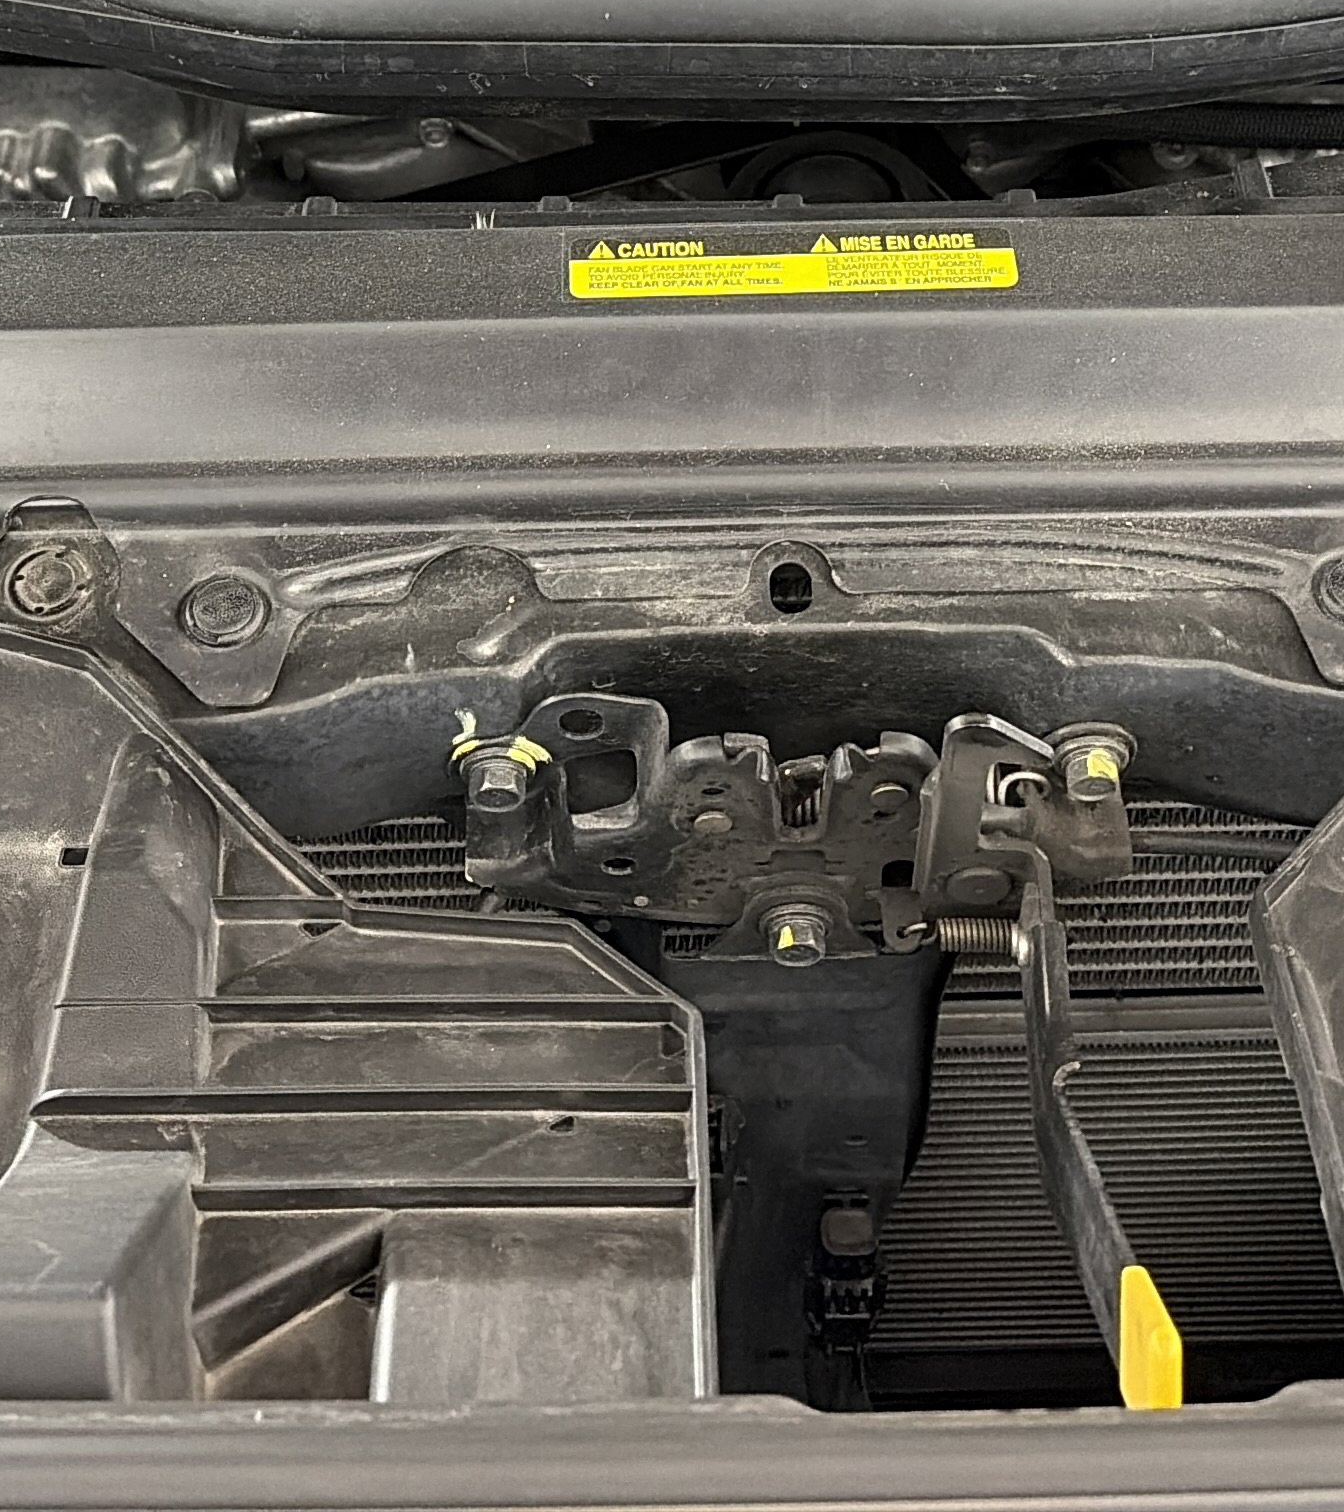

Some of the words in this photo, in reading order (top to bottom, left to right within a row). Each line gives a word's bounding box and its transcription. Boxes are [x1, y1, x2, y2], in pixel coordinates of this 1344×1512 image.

[839, 235, 883, 252] MISE
[885, 235, 911, 251] EN
[913, 233, 976, 250] GARDE
[617, 241, 704, 258] CAUTION
[612, 265, 649, 273] BLADE
[677, 263, 713, 272] START
[714, 262, 730, 271] AT
[731, 262, 754, 270] ANY
[902, 261, 931, 269] TOUT
[606, 272, 640, 281] AVOID
[642, 271, 702, 281] PERSONAL
[905, 268, 943, 277] TOUTE
[588, 281, 618, 290] KEEP
[622, 280, 660, 289] CLEAR
[706, 278, 721, 287] AT
[723, 278, 744, 286] ALL
[845, 277, 887, 287] JAMAIS
